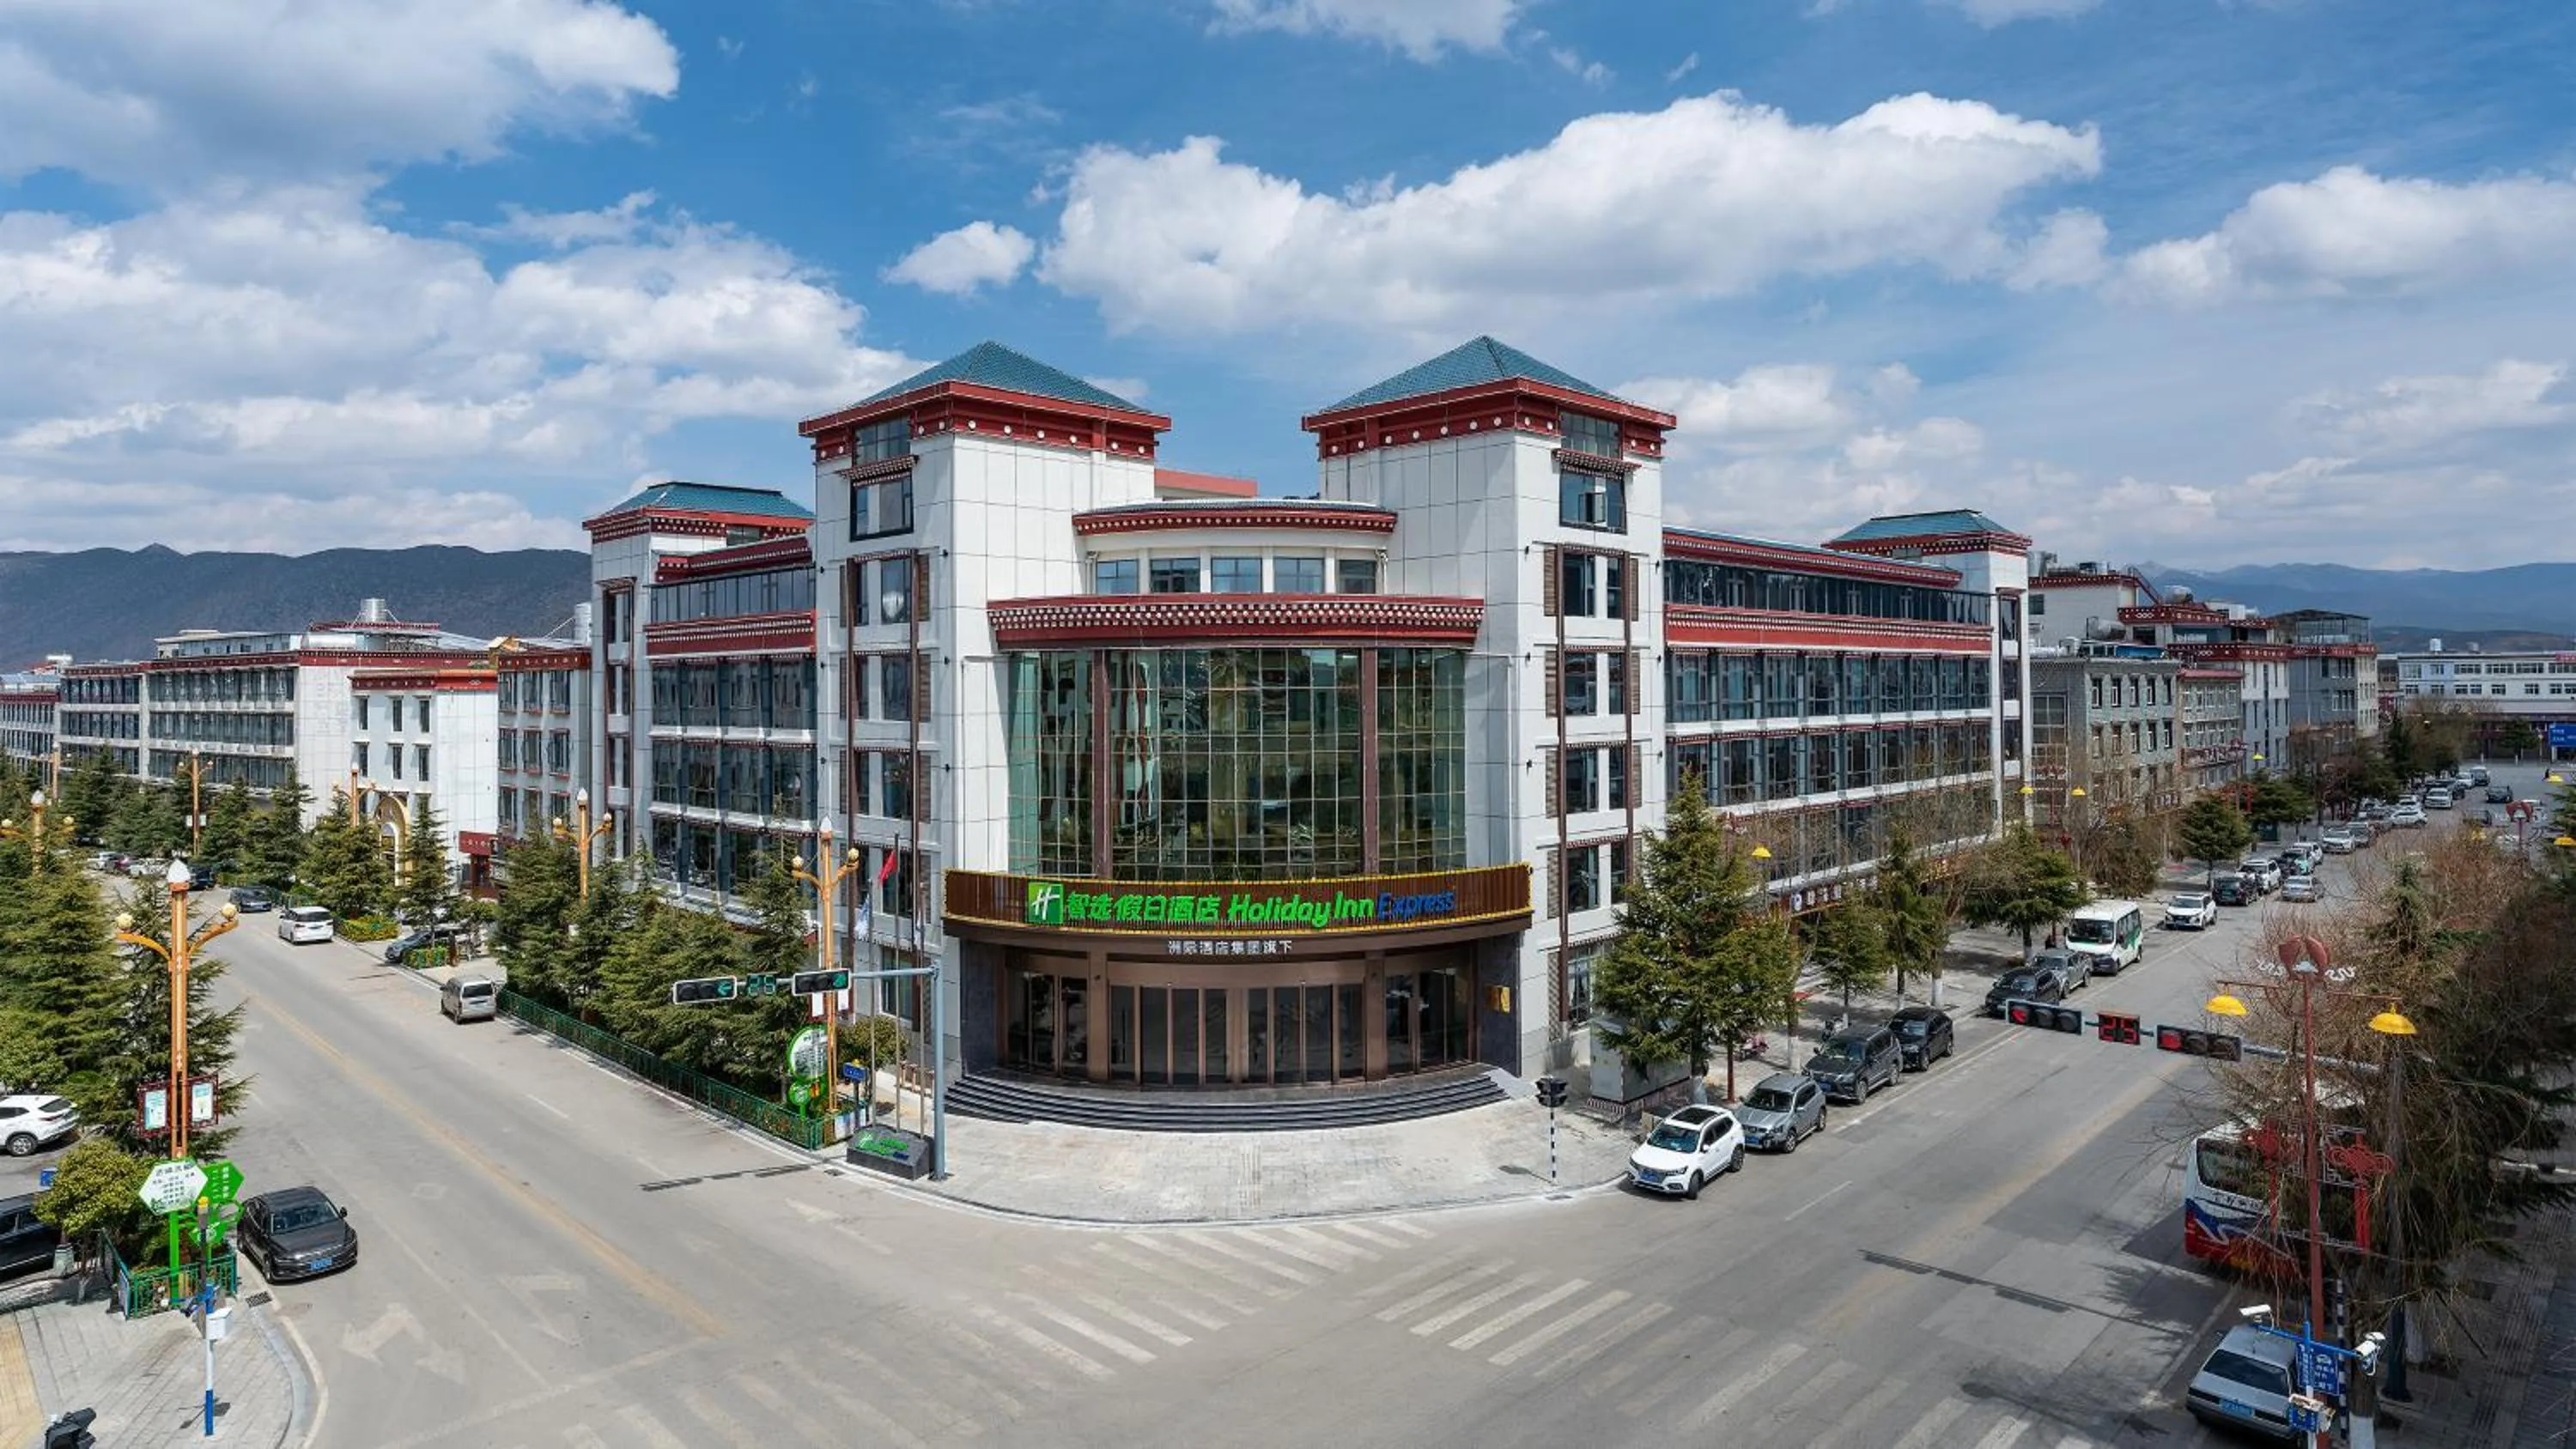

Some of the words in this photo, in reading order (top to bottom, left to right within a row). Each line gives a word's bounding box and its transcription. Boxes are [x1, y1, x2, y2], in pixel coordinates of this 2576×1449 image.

[1067, 891, 1221, 921] 智选假日酒店
[1227, 894, 1331, 928] Holiday
[1334, 891, 1374, 919] Inn
[1377, 889, 1455, 921] Express
[1168, 940, 1292, 955] 洲际酒店集团旗下
[2101, 1016, 2137, 1044] 25
